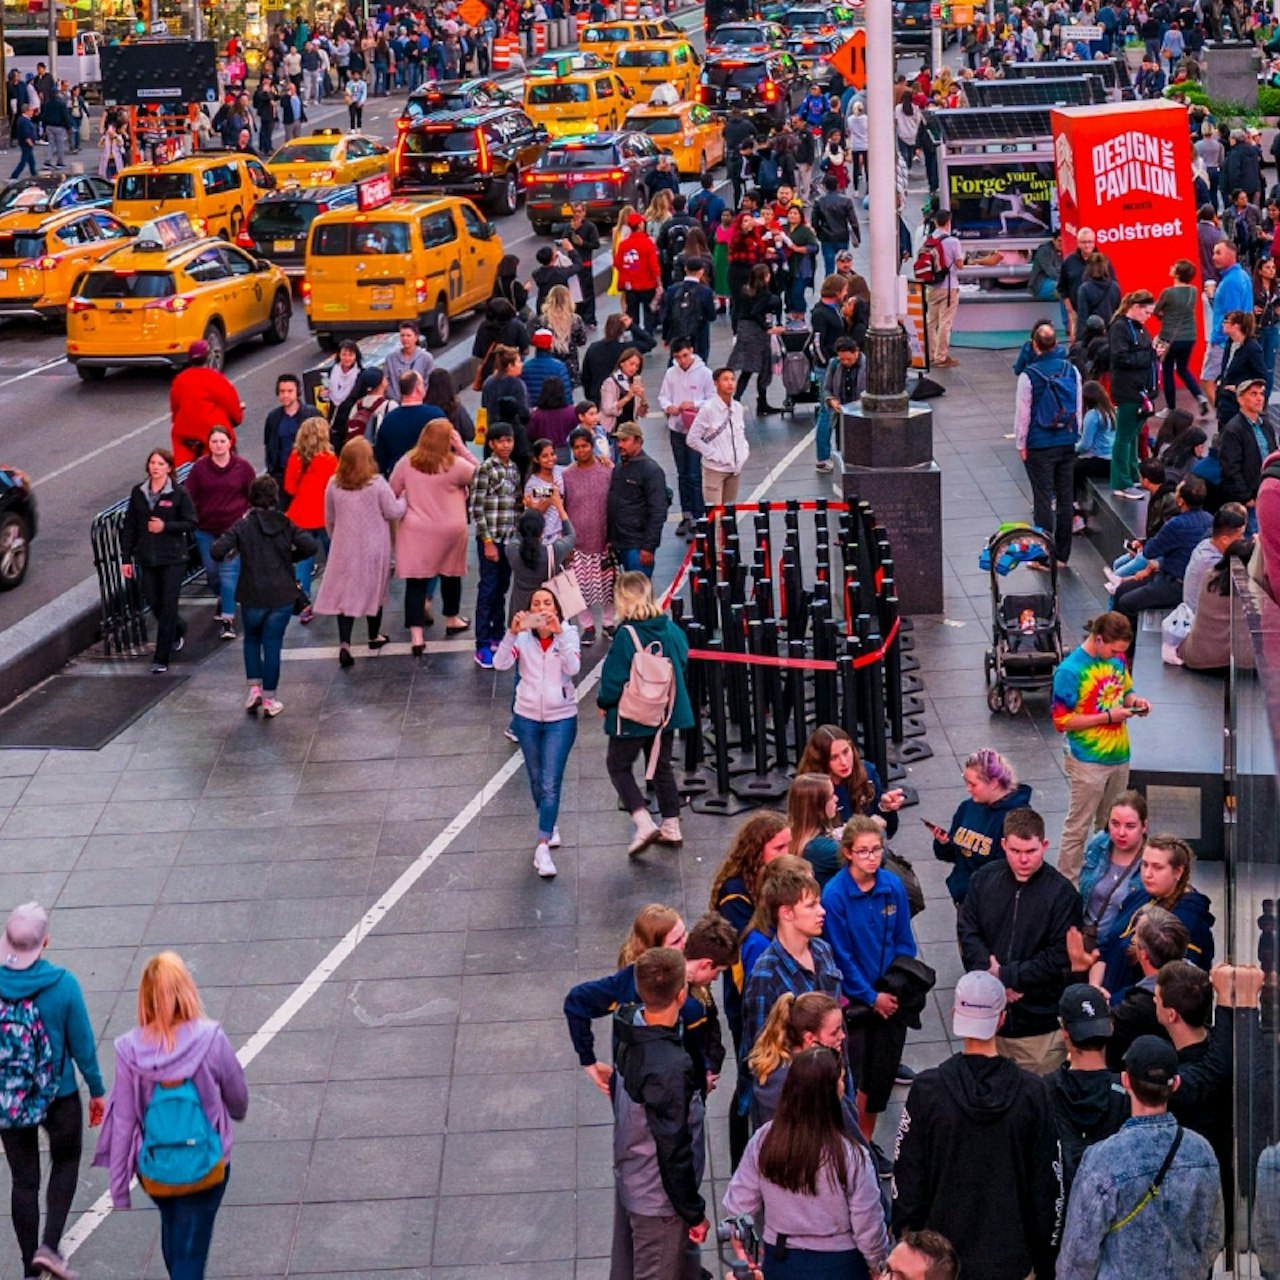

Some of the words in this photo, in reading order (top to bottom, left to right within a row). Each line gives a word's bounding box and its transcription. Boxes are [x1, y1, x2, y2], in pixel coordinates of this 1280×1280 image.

[1092, 131, 1159, 176] DESIGN
[1161, 137, 1176, 170] NYC
[950, 172, 1007, 198] Forge
[1007, 171, 1037, 186] your
[1095, 161, 1178, 207] PAVILION
[1097, 218, 1183, 244] solstreet
